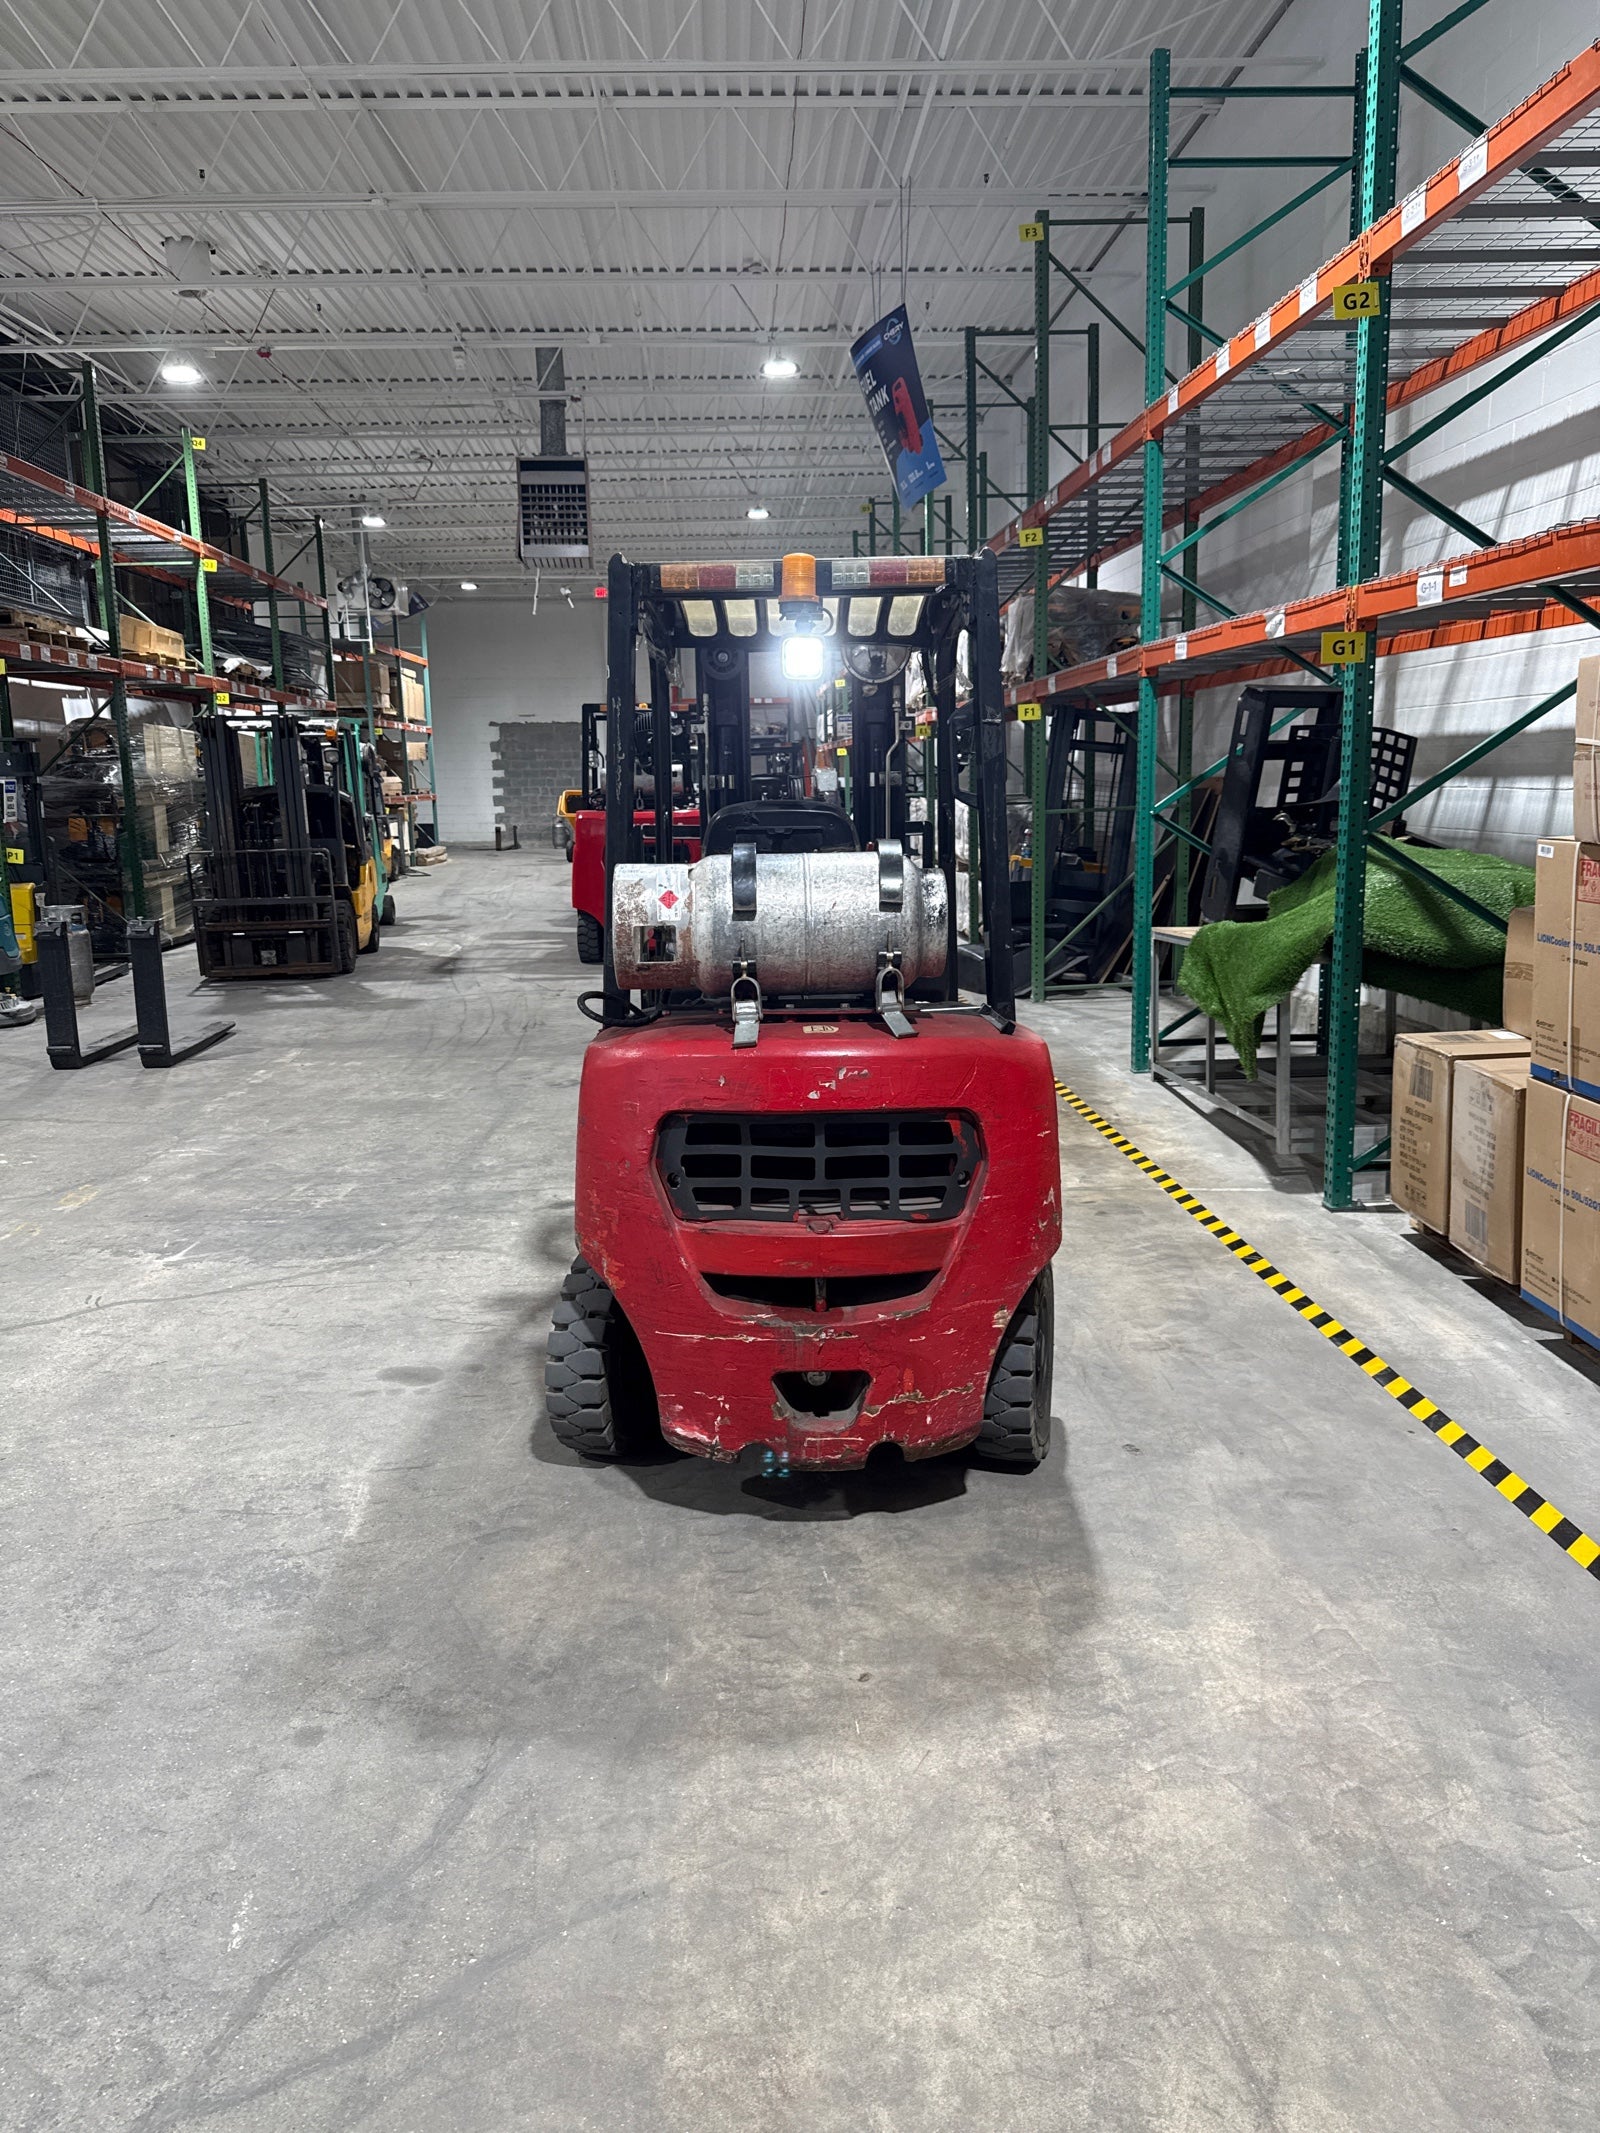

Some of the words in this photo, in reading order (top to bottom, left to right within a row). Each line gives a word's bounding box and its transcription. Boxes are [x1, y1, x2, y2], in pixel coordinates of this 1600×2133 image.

[1025, 227, 1038, 238] F3
[1343, 291, 1371, 310] G2
[869, 384, 890, 417] TANK
[192, 439, 203, 447] Q4
[1025, 532, 1037, 542] F2
[1420, 581, 1438, 594] G-1-1
[1332, 639, 1356, 656] G1
[1024, 708, 1036, 717] F1
[7, 851, 19, 861] P1
